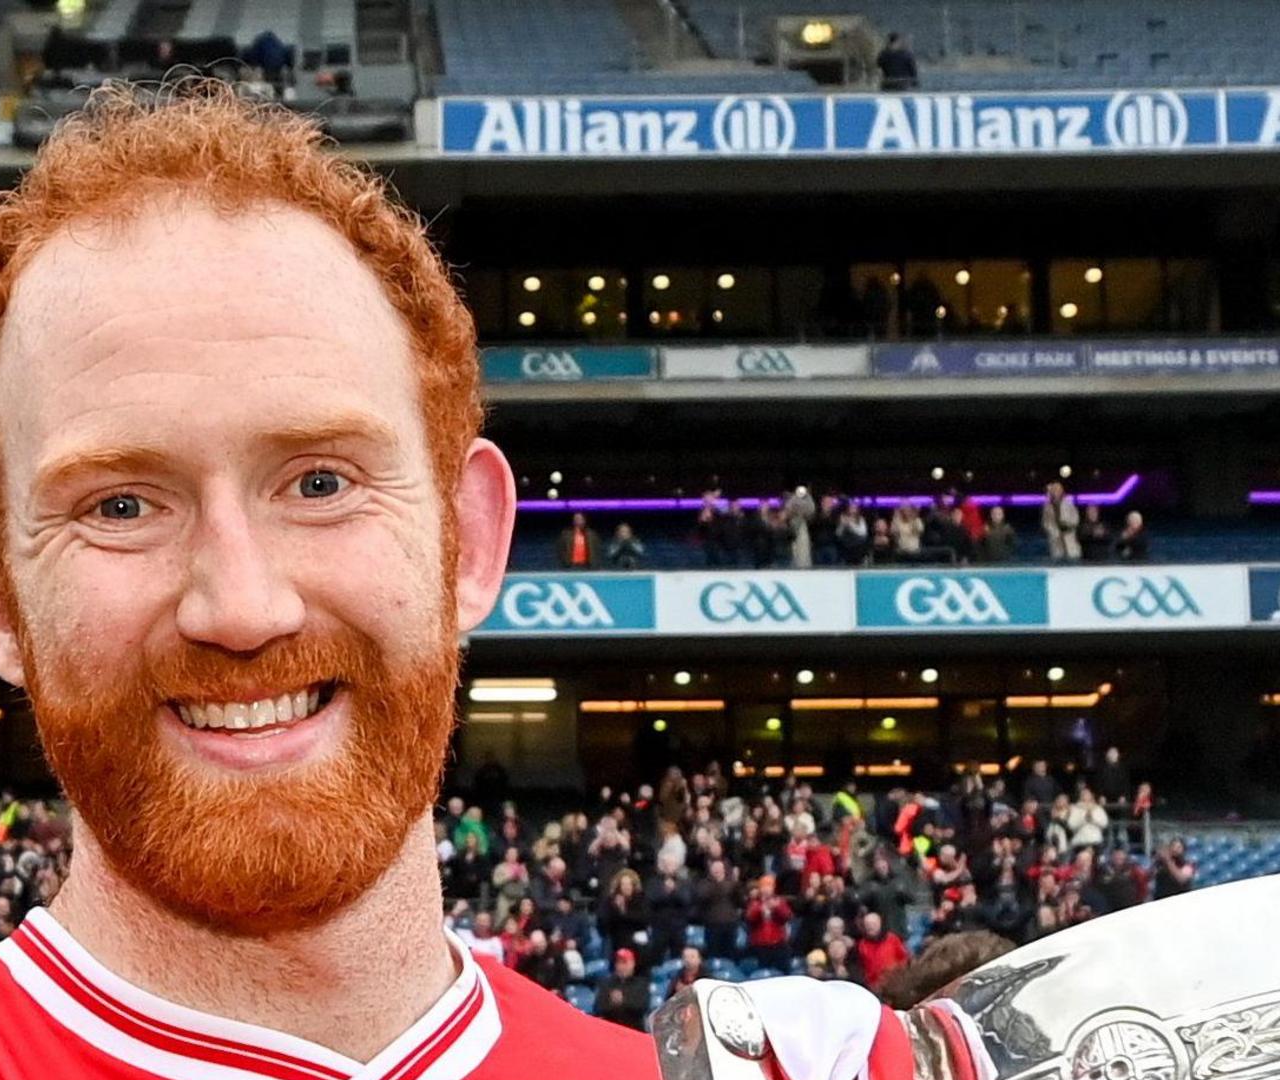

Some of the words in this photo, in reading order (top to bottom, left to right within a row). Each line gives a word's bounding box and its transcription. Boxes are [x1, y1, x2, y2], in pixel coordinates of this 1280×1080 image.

[475, 98, 697, 153] Allianz
[868, 95, 1092, 150] Allianz
[521, 351, 583, 379] GAA
[734, 348, 797, 375] GAA
[1093, 349, 1187, 367] MEETINGS
[1207, 348, 1280, 366] EVENTS
[503, 581, 614, 626] GAA
[699, 578, 809, 624] GAA
[895, 576, 1010, 623] GAA
[1091, 574, 1204, 620] GAA
